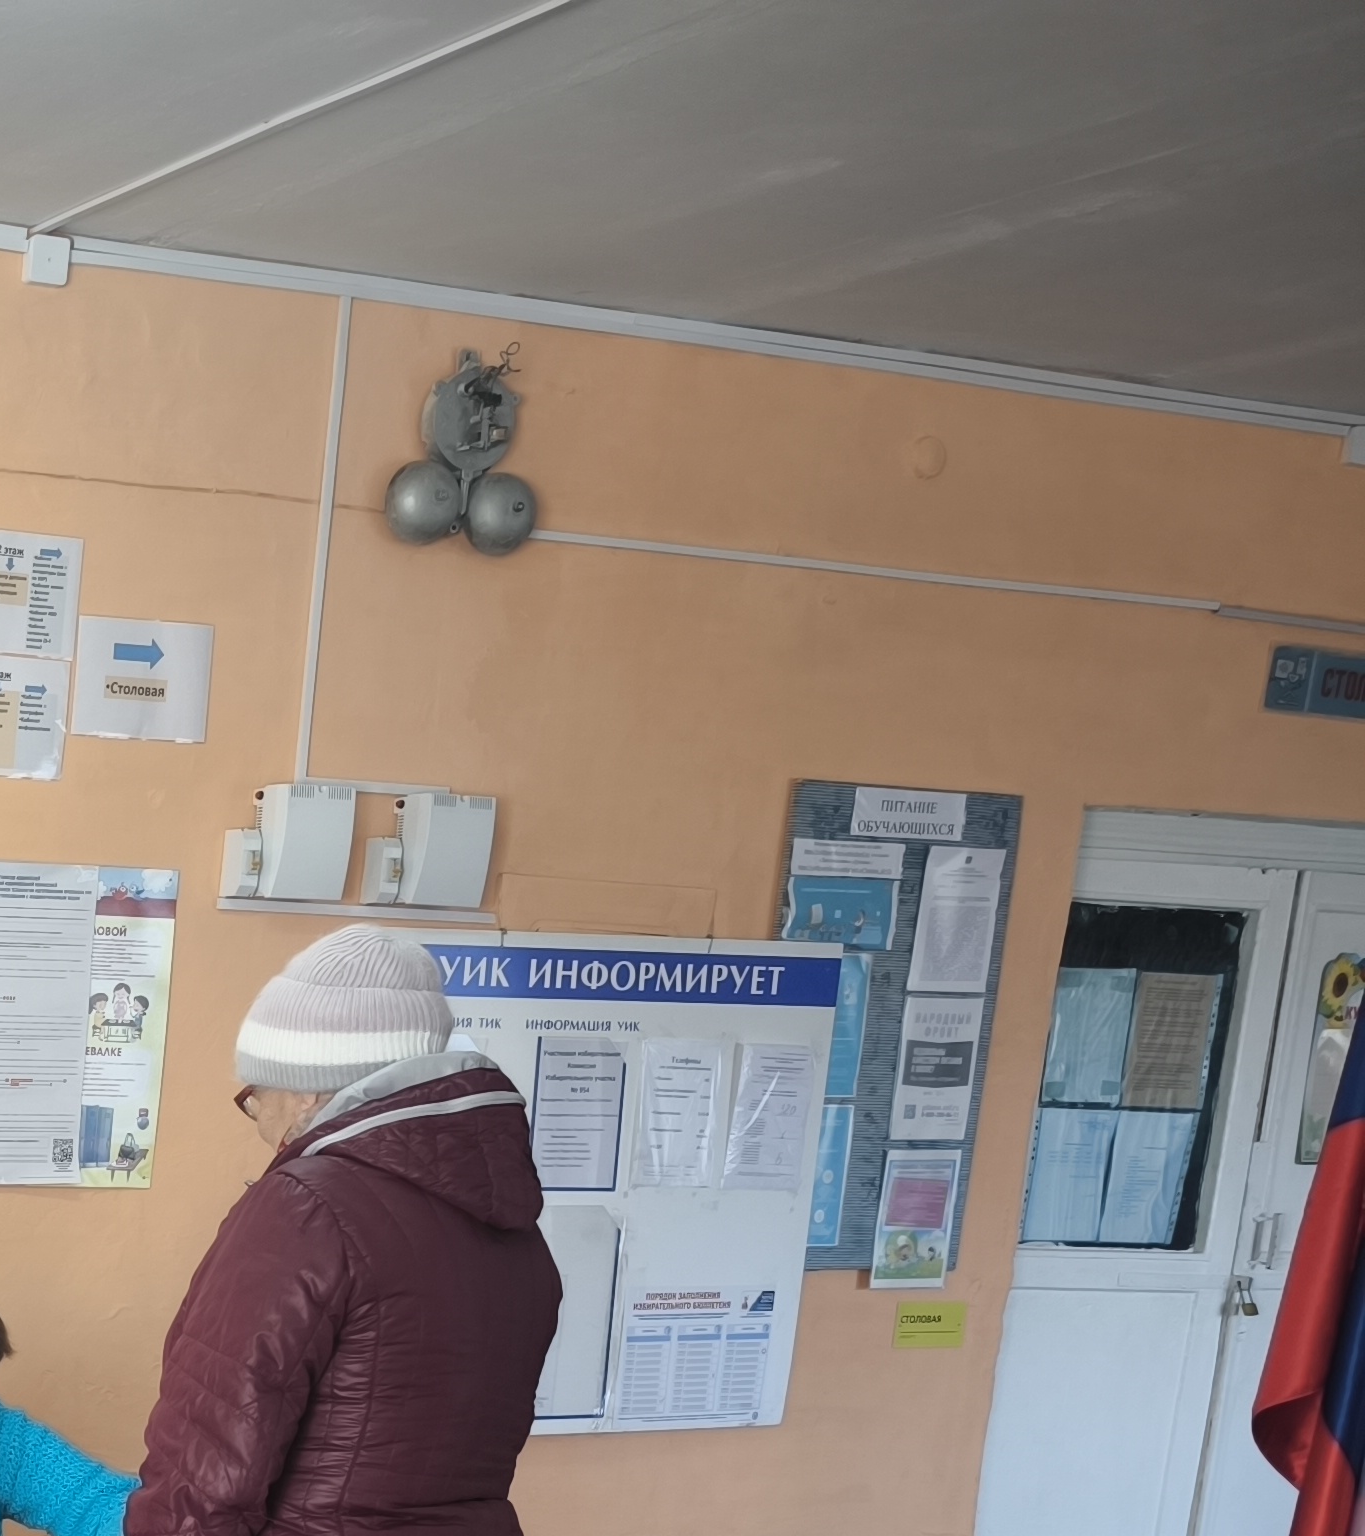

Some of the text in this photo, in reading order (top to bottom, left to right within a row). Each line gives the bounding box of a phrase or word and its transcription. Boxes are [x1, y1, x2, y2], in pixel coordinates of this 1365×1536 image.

[3, 547, 24, 556] этаж
[110, 681, 165, 699] Столовая
[880, 800, 939, 815] ПИТАНИЕ
[857, 820, 955, 836] ОБУЧАЮЩИХСЯ
[439, 955, 785, 995] УИК ИНФОРМИРУЕТ
[478, 1017, 502, 1030] ТИК
[526, 1018, 611, 1032] ИНФОРМАЦИЯ
[617, 1020, 640, 1032] УИК
[85, 1046, 122, 1057] ЕВАЛКЕ
[900, 1315, 942, 1324] СТОЛОВАЯ
